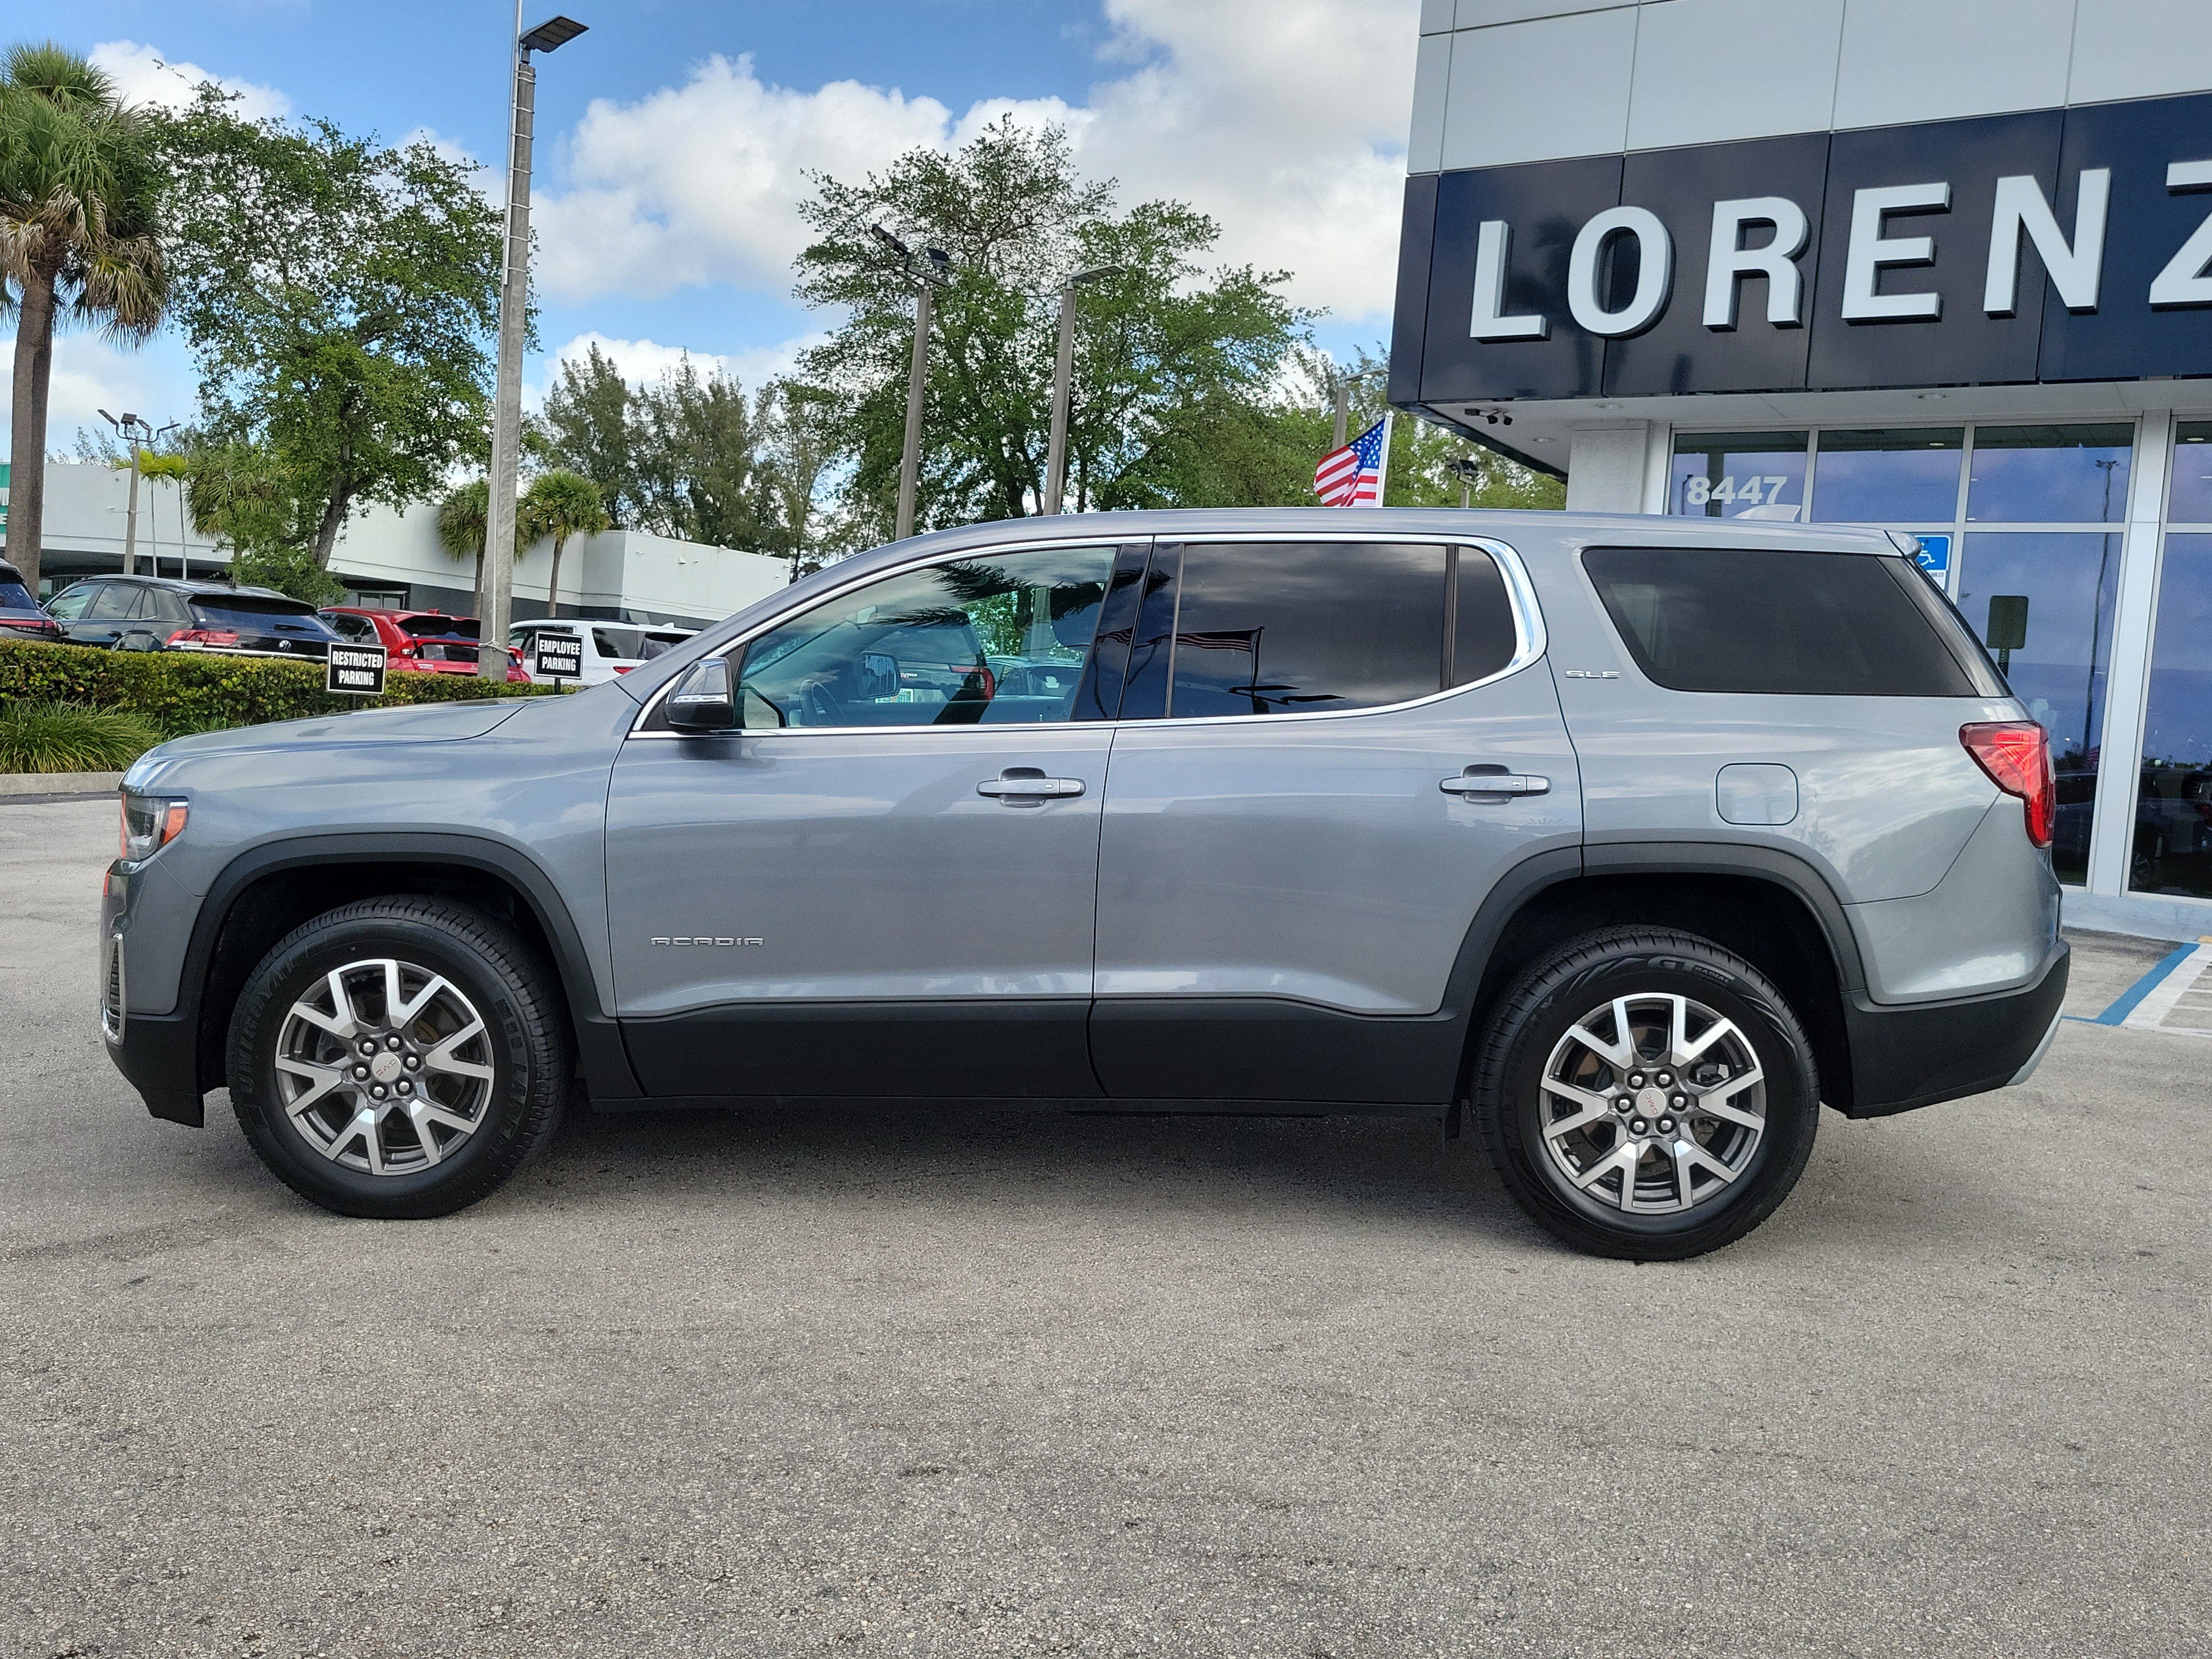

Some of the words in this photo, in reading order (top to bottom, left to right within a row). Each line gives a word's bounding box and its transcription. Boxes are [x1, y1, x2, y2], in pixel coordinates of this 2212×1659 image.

[1469, 161, 2212, 341] LORENZ
[1687, 476, 1787, 505] 8447
[539, 639, 580, 655] EMPLOYEE
[332, 651, 383, 668] RESTRICTED
[541, 656, 576, 671] PARKING
[338, 670, 374, 686] PARKING
[651, 937, 764, 946] ACADIA
[376, 1059, 397, 1075] GMC
[1643, 1091, 1658, 1114] GMC
